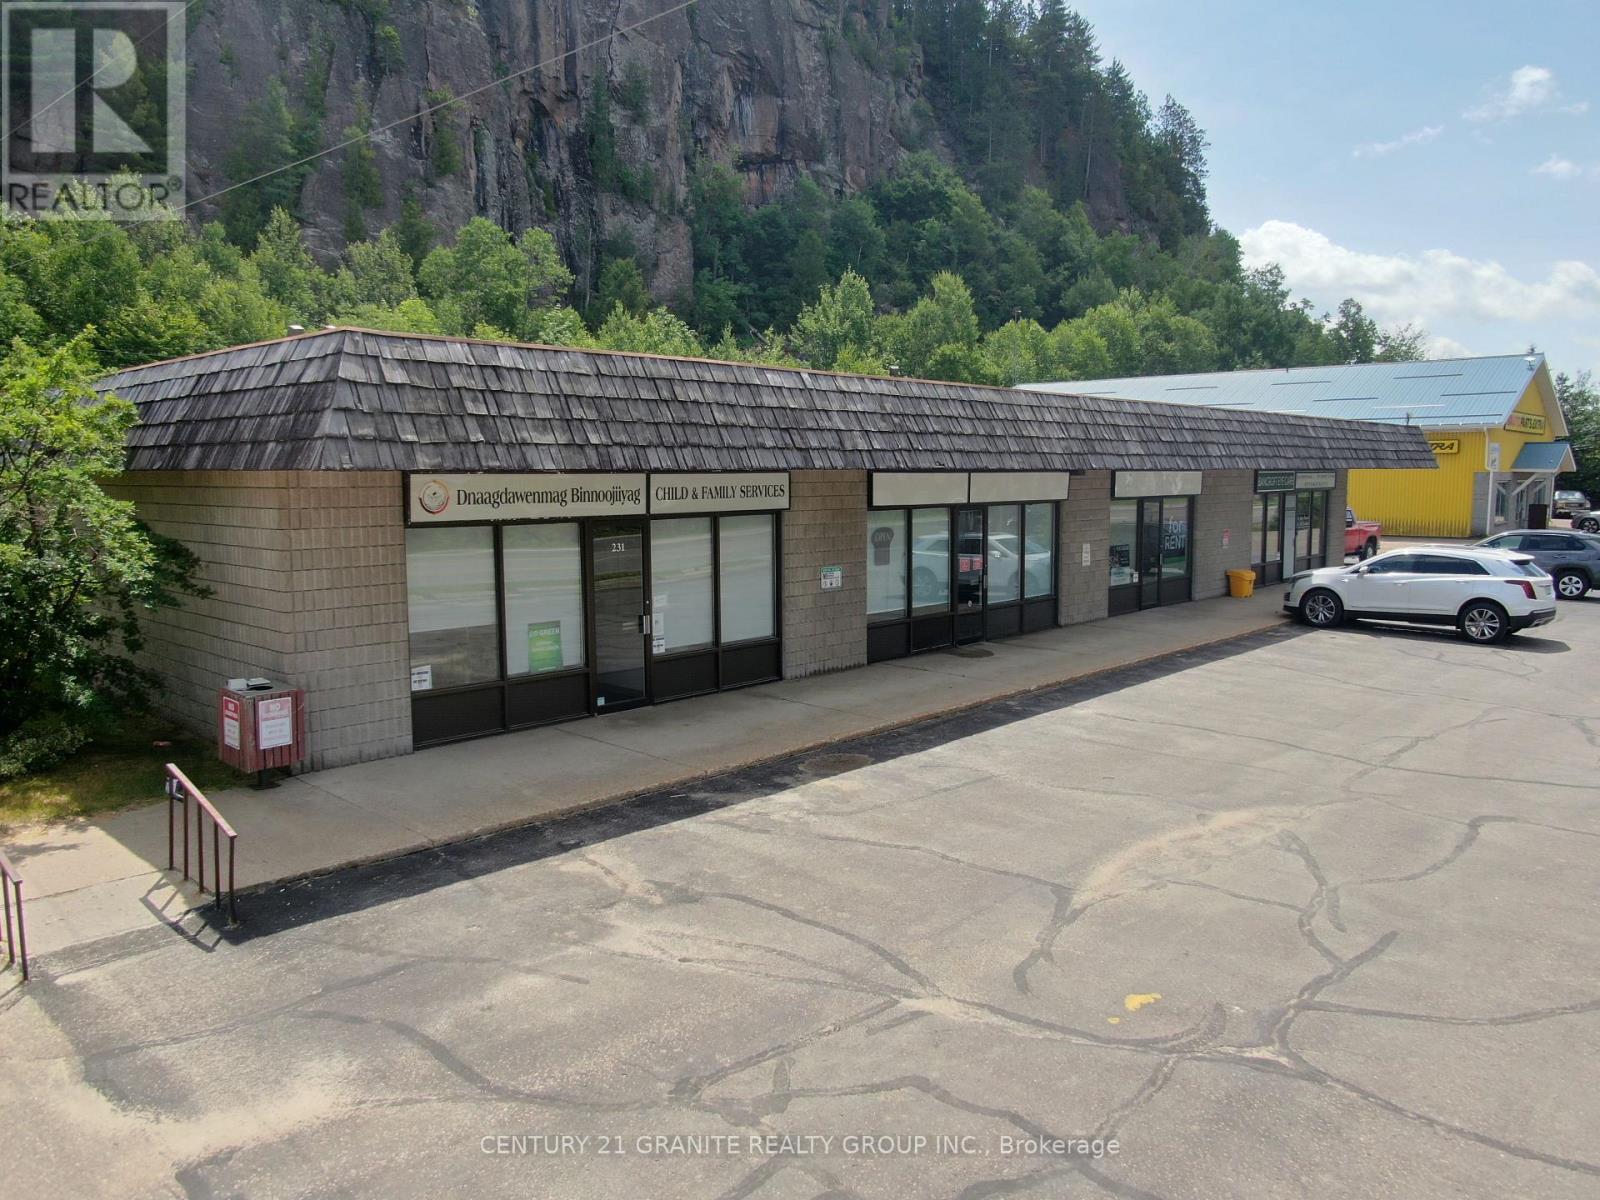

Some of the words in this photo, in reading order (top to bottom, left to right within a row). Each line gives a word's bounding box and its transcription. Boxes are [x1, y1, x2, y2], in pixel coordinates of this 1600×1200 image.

[456, 487, 567, 508] Dnaagdawenmag
[571, 486, 641, 505] Binnoojiiyag
[655, 486, 689, 501] CHILD
[691, 487, 698, 500] &
[701, 485, 737, 499] FAMILY
[739, 484, 785, 498] SERVICES
[611, 542, 625, 552] 231
[1164, 535, 1186, 550] RENT
